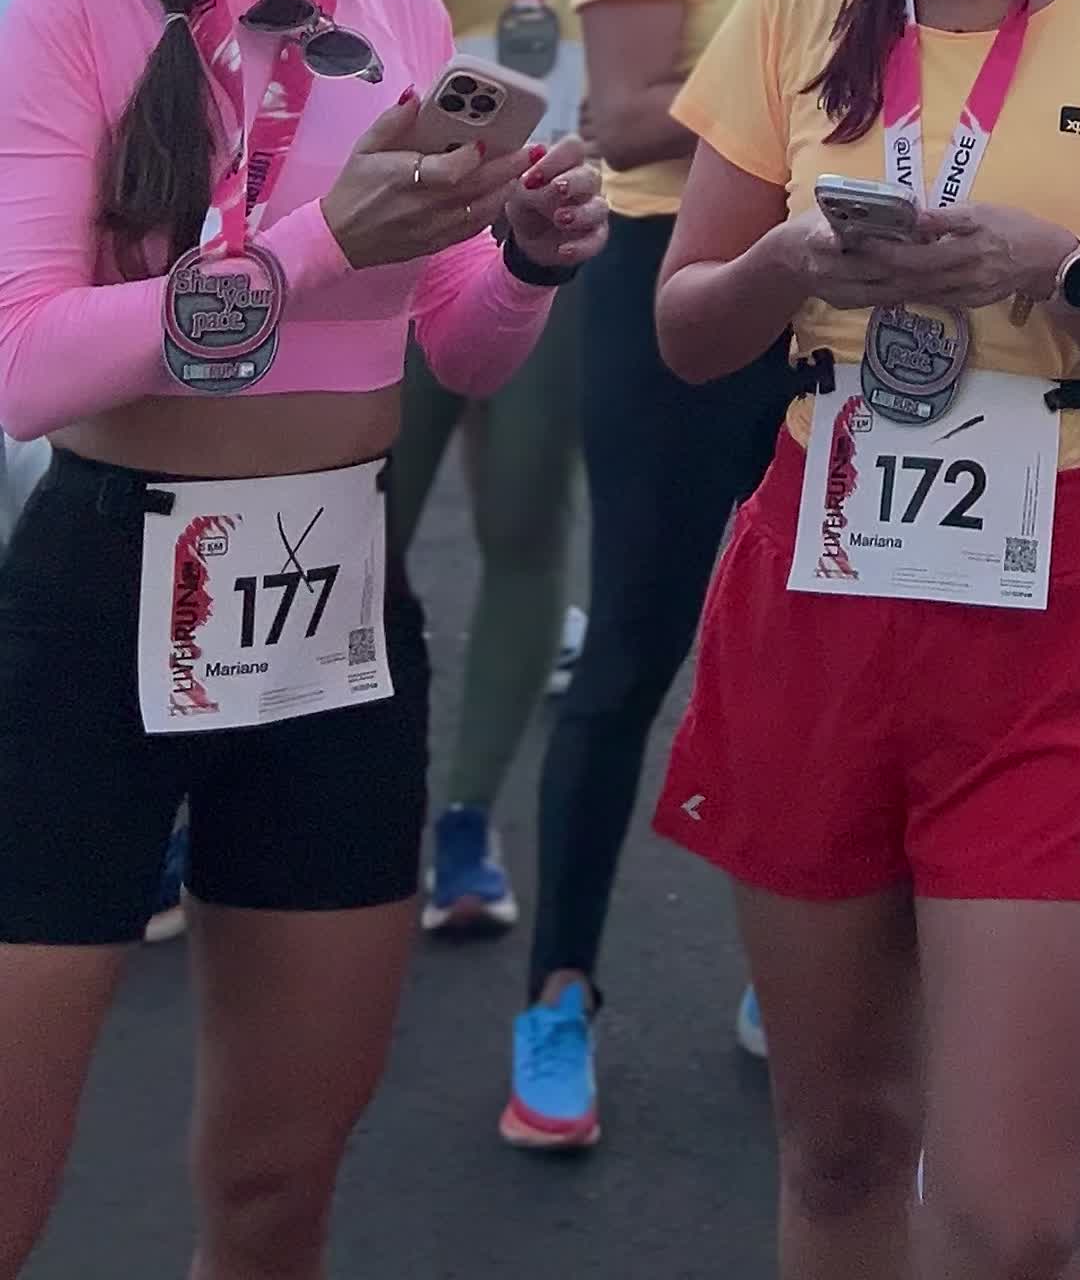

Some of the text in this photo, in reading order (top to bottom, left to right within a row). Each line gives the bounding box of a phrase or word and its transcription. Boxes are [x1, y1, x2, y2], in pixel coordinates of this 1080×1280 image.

[939, 135, 976, 208] IENCE
[191, 312, 246, 338] pace
[876, 455, 987, 530] 172
[850, 533, 902, 549] Mariana
[234, 564, 341, 648] 177
